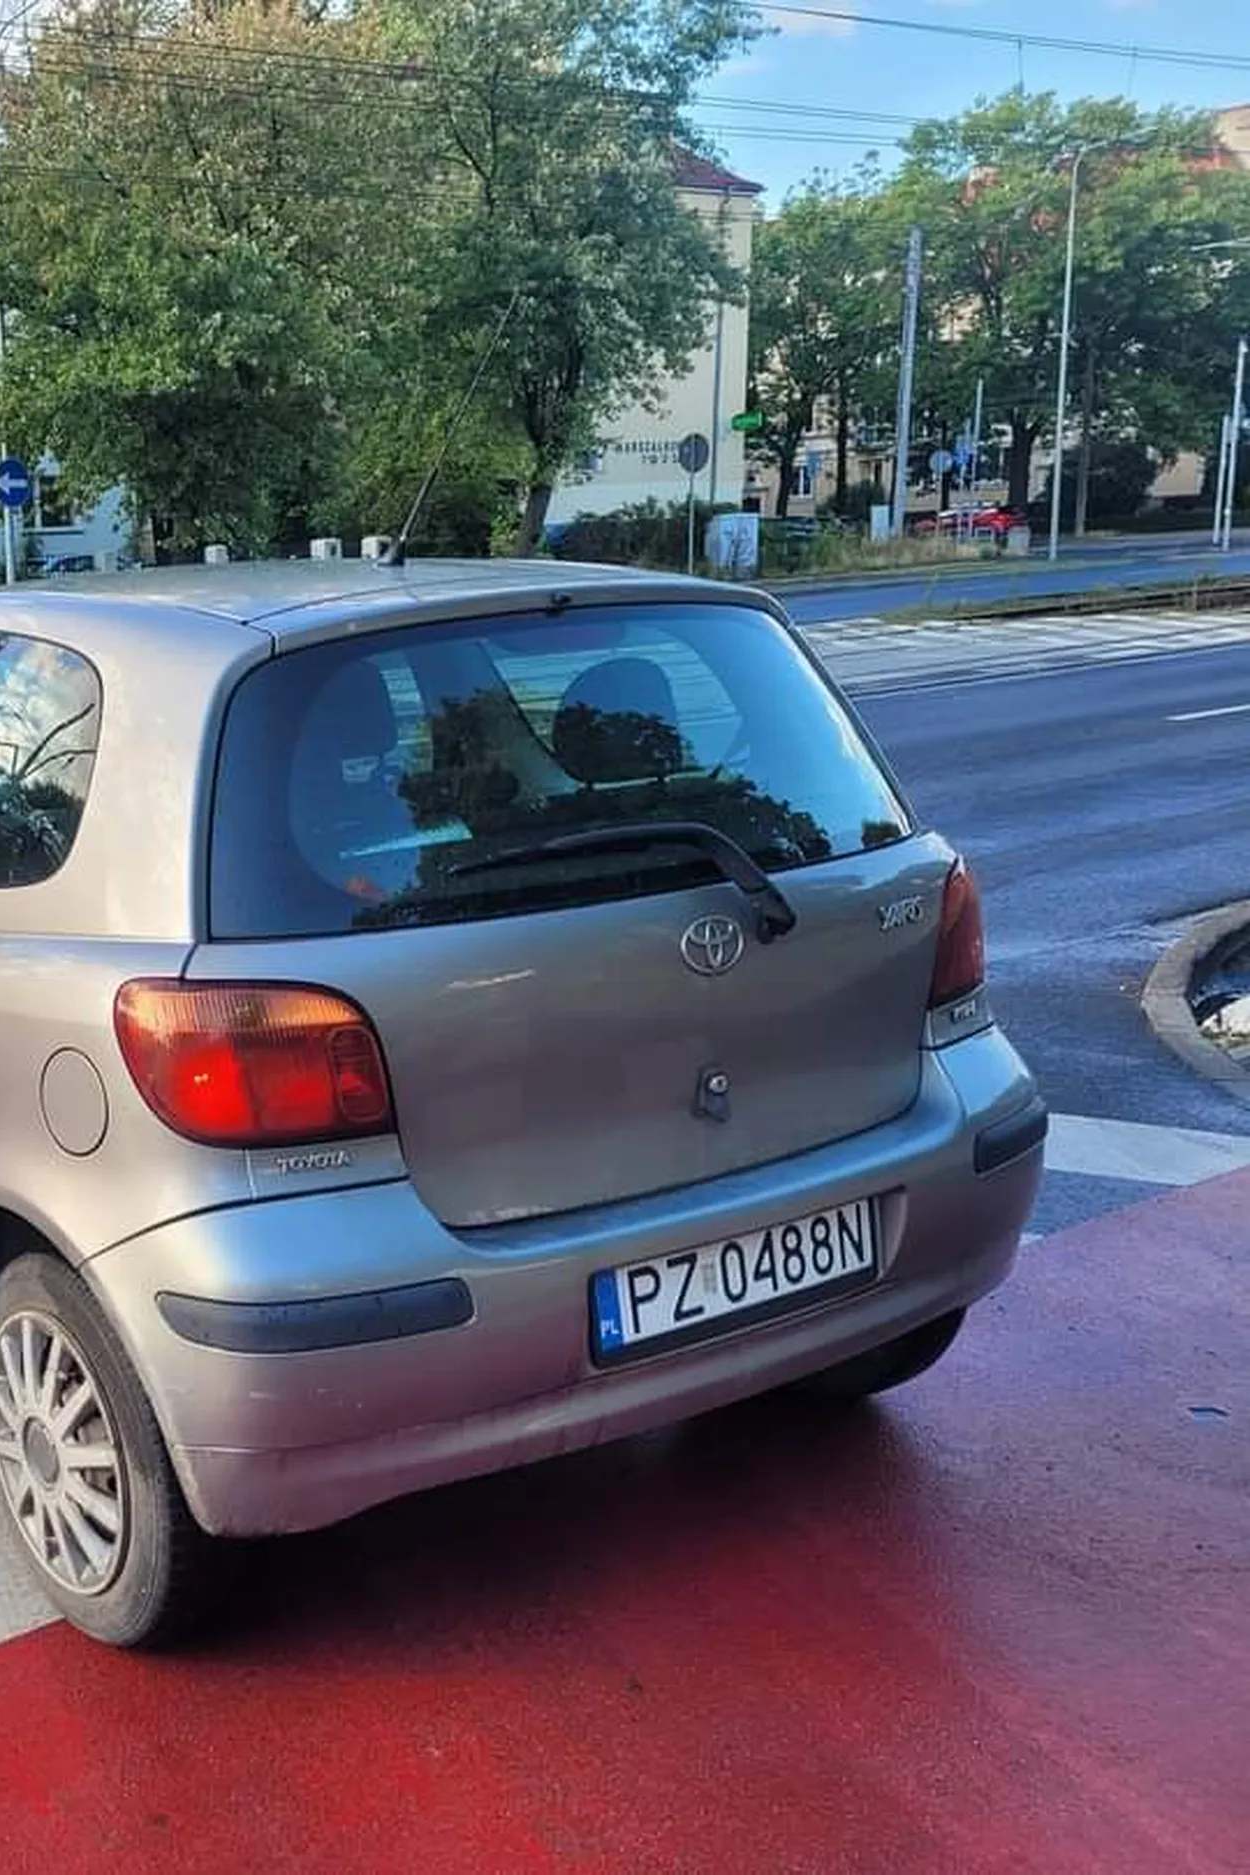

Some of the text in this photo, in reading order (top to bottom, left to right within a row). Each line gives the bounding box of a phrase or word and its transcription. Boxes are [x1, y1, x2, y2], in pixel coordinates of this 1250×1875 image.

[277, 1150, 350, 1173] TOYOTA
[628, 1203, 865, 1333] PZ 0488N
[601, 1322, 619, 1338] PL
